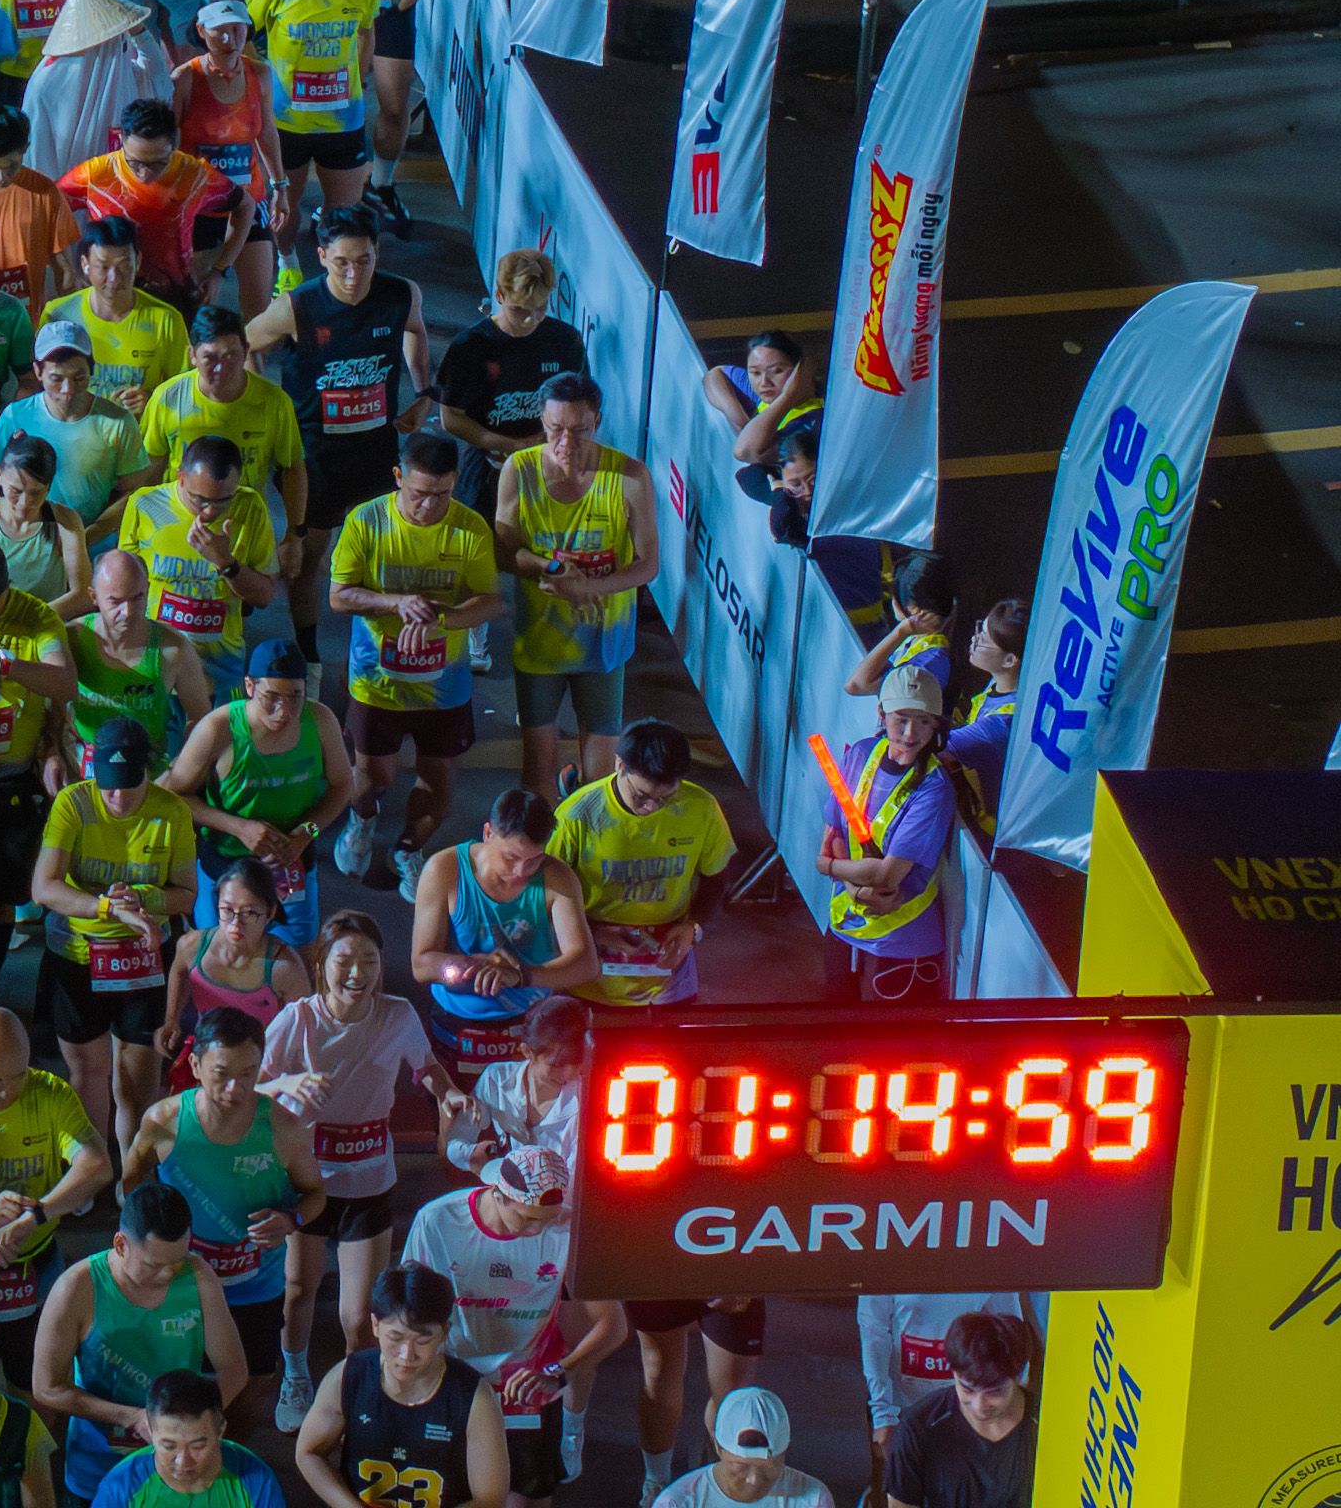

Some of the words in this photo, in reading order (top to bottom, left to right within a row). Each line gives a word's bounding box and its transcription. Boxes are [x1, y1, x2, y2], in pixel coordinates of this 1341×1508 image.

[309, 83, 345, 97] 82535
[919, 193, 944, 240] ngày
[342, 400, 381, 417] 84215
[684, 489, 765, 669] VELOSAR
[1097, 616, 1124, 714] ACTIVE
[1117, 453, 1179, 621] PRO
[174, 610, 221, 627] 80690
[110, 955, 157, 971] 80947
[604, 1057, 1157, 1173] 01:14:59
[334, 1137, 383, 1155] 82094
[1278, 1157, 1341, 1232] H
[673, 1200, 1049, 1255] GARMIN
[358, 1459, 444, 1508] 23
